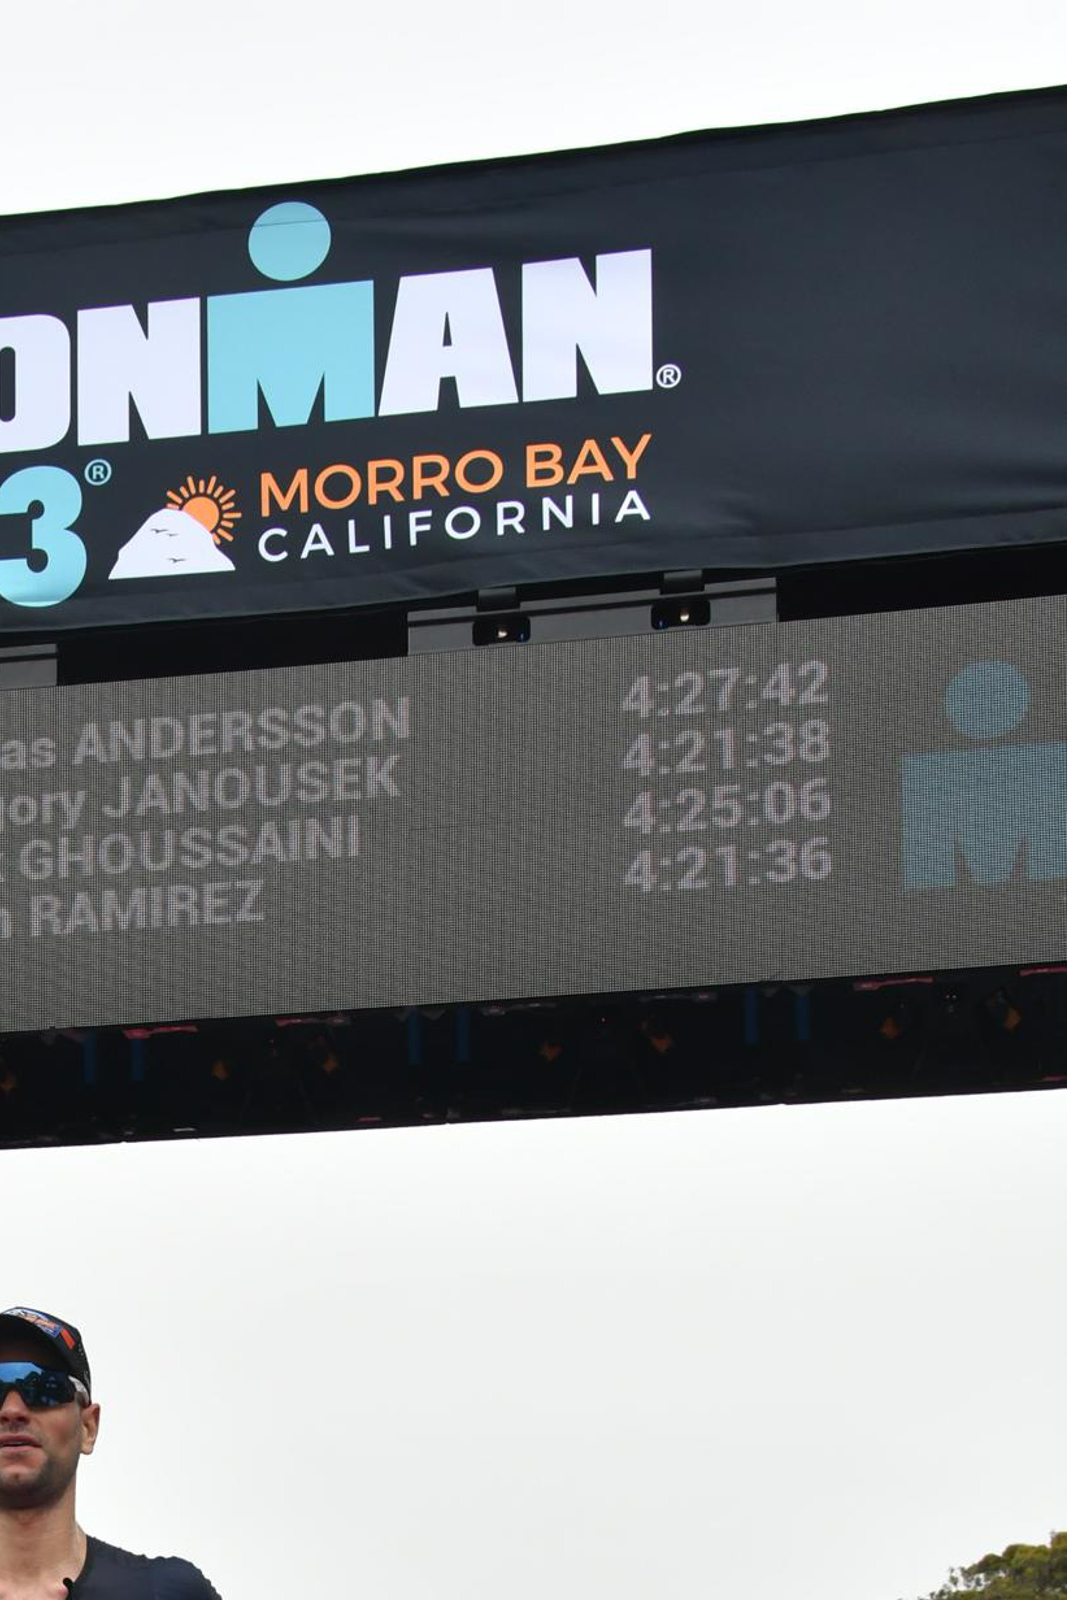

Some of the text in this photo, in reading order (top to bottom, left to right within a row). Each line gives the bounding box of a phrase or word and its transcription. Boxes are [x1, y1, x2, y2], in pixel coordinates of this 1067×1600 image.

[260, 433, 653, 517] MORRO BAY
[258, 490, 651, 562] CALIFORNIA
[73, 696, 410, 765] ANDERSSON
[622, 660, 829, 718] 4:27:42
[103, 754, 402, 818] JANOUSEK
[621, 719, 829, 776] 4:21:38
[20, 814, 360, 880] GHOUSSAINI
[623, 777, 831, 834] 4:25:06
[31, 879, 265, 937] RAMIREZ
[623, 836, 832, 892] 4:21:36
